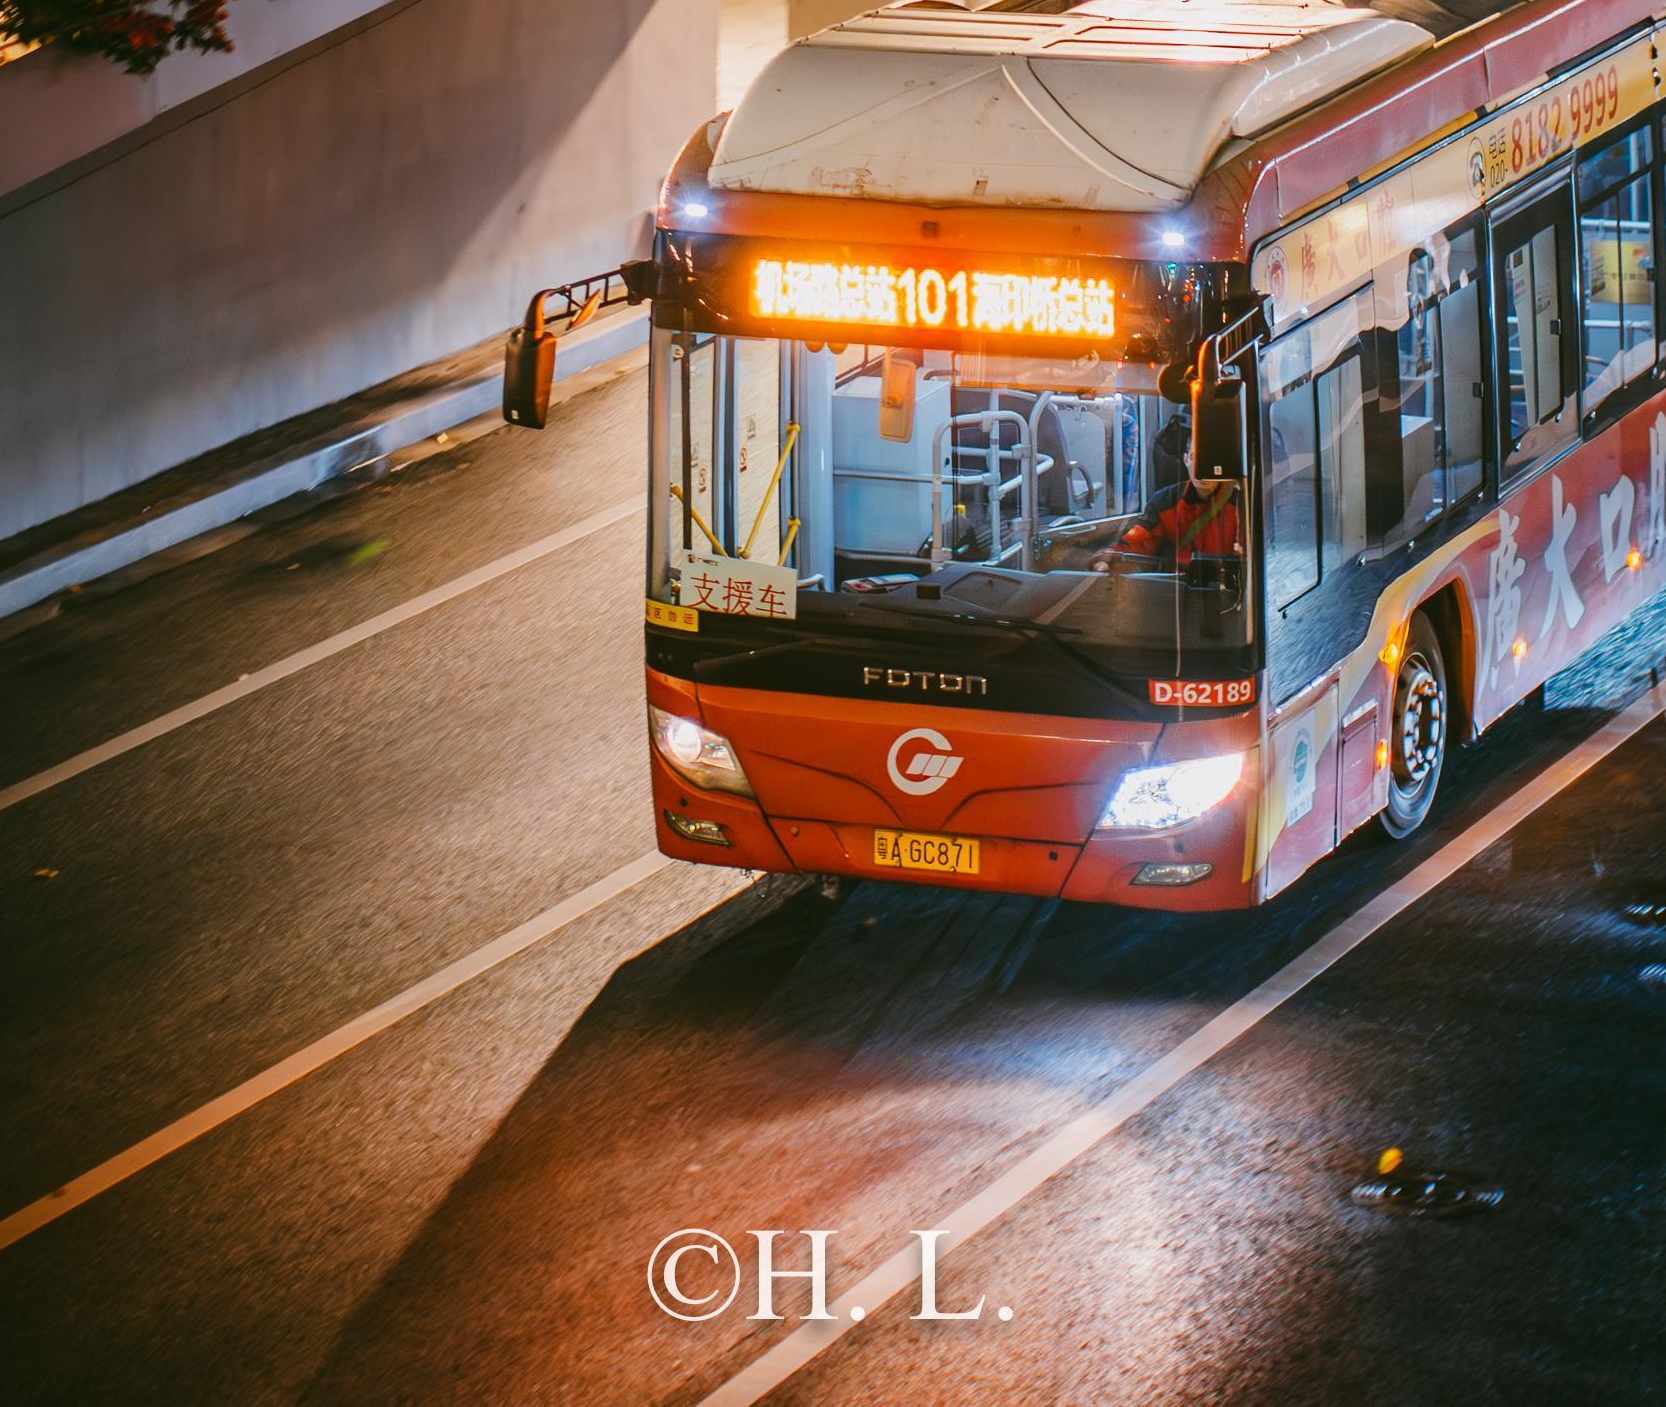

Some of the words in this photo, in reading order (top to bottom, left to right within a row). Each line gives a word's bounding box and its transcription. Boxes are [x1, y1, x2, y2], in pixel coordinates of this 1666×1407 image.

[1511, 96, 1562, 174] 8182
[1569, 65, 1618, 141] 9999
[1489, 127, 1507, 159] 电话
[688, 572, 787, 618] 支援车
[863, 666, 988, 695] FOTON
[1154, 676, 1252, 705] D-62189
